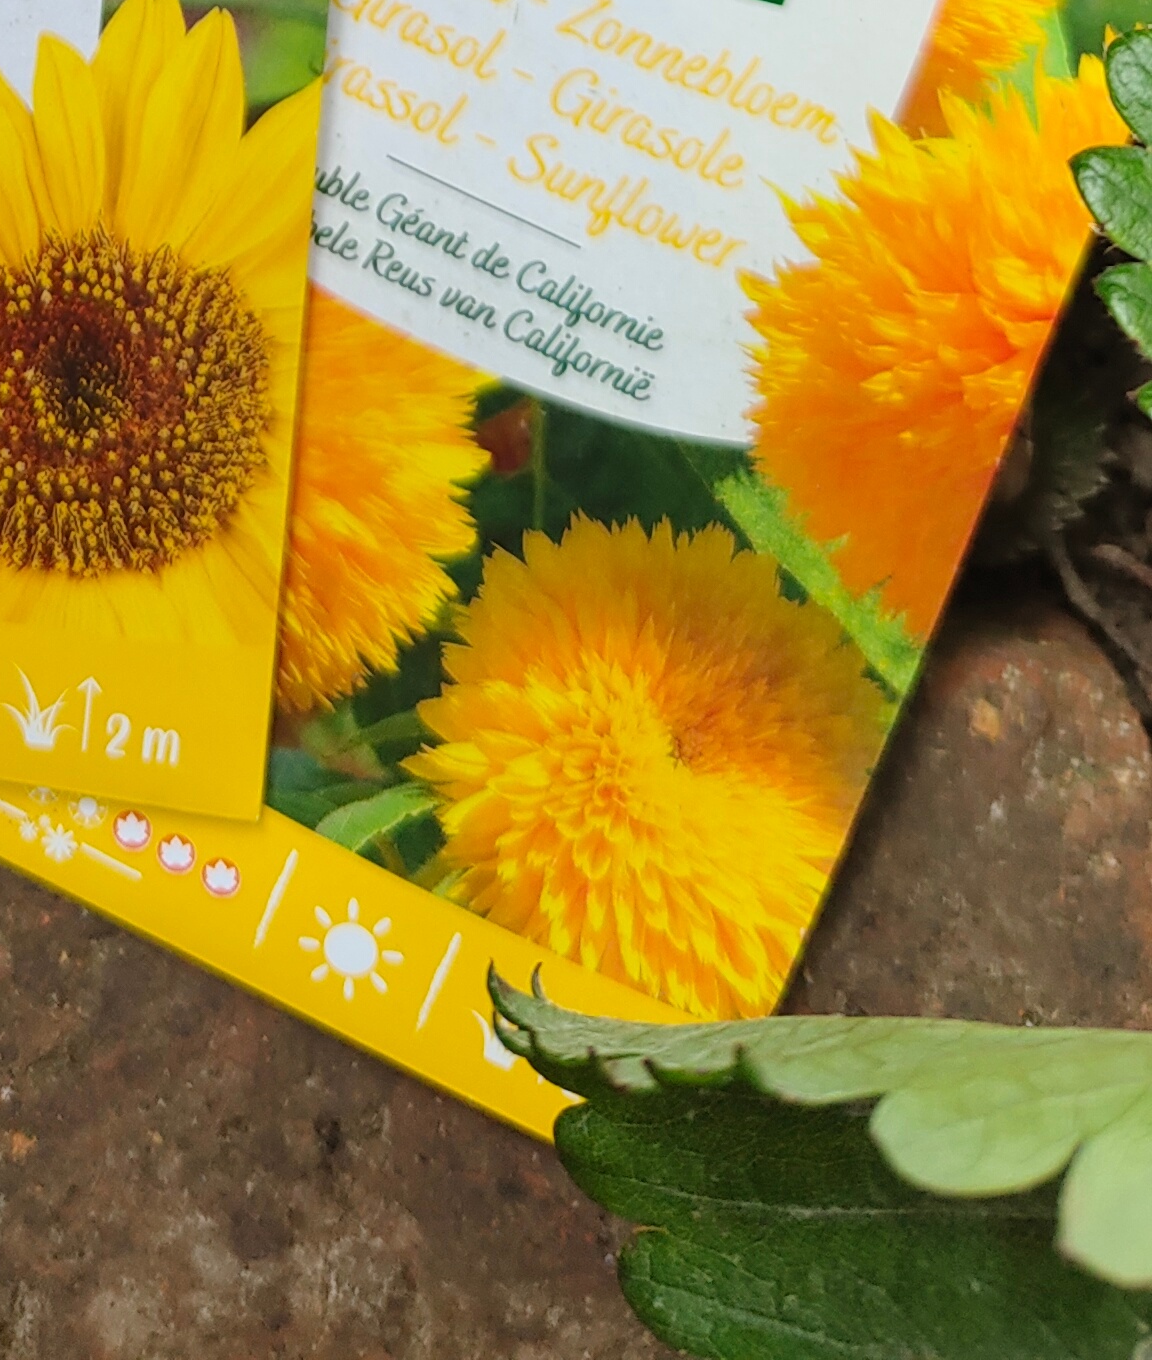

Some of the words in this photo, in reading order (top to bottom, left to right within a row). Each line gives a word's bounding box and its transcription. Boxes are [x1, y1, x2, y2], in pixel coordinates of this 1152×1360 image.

[550, 66, 745, 189] Girasole
[507, 133, 747, 268] Sunflower
[362, 238, 436, 297] Reus
[439, 286, 497, 330] van
[503, 308, 655, 400] Californië
[376, 191, 470, 260] Géant
[471, 242, 510, 279] de
[516, 260, 664, 351] Californie
[105, 712, 131, 759] 2
[142, 726, 181, 766] m
